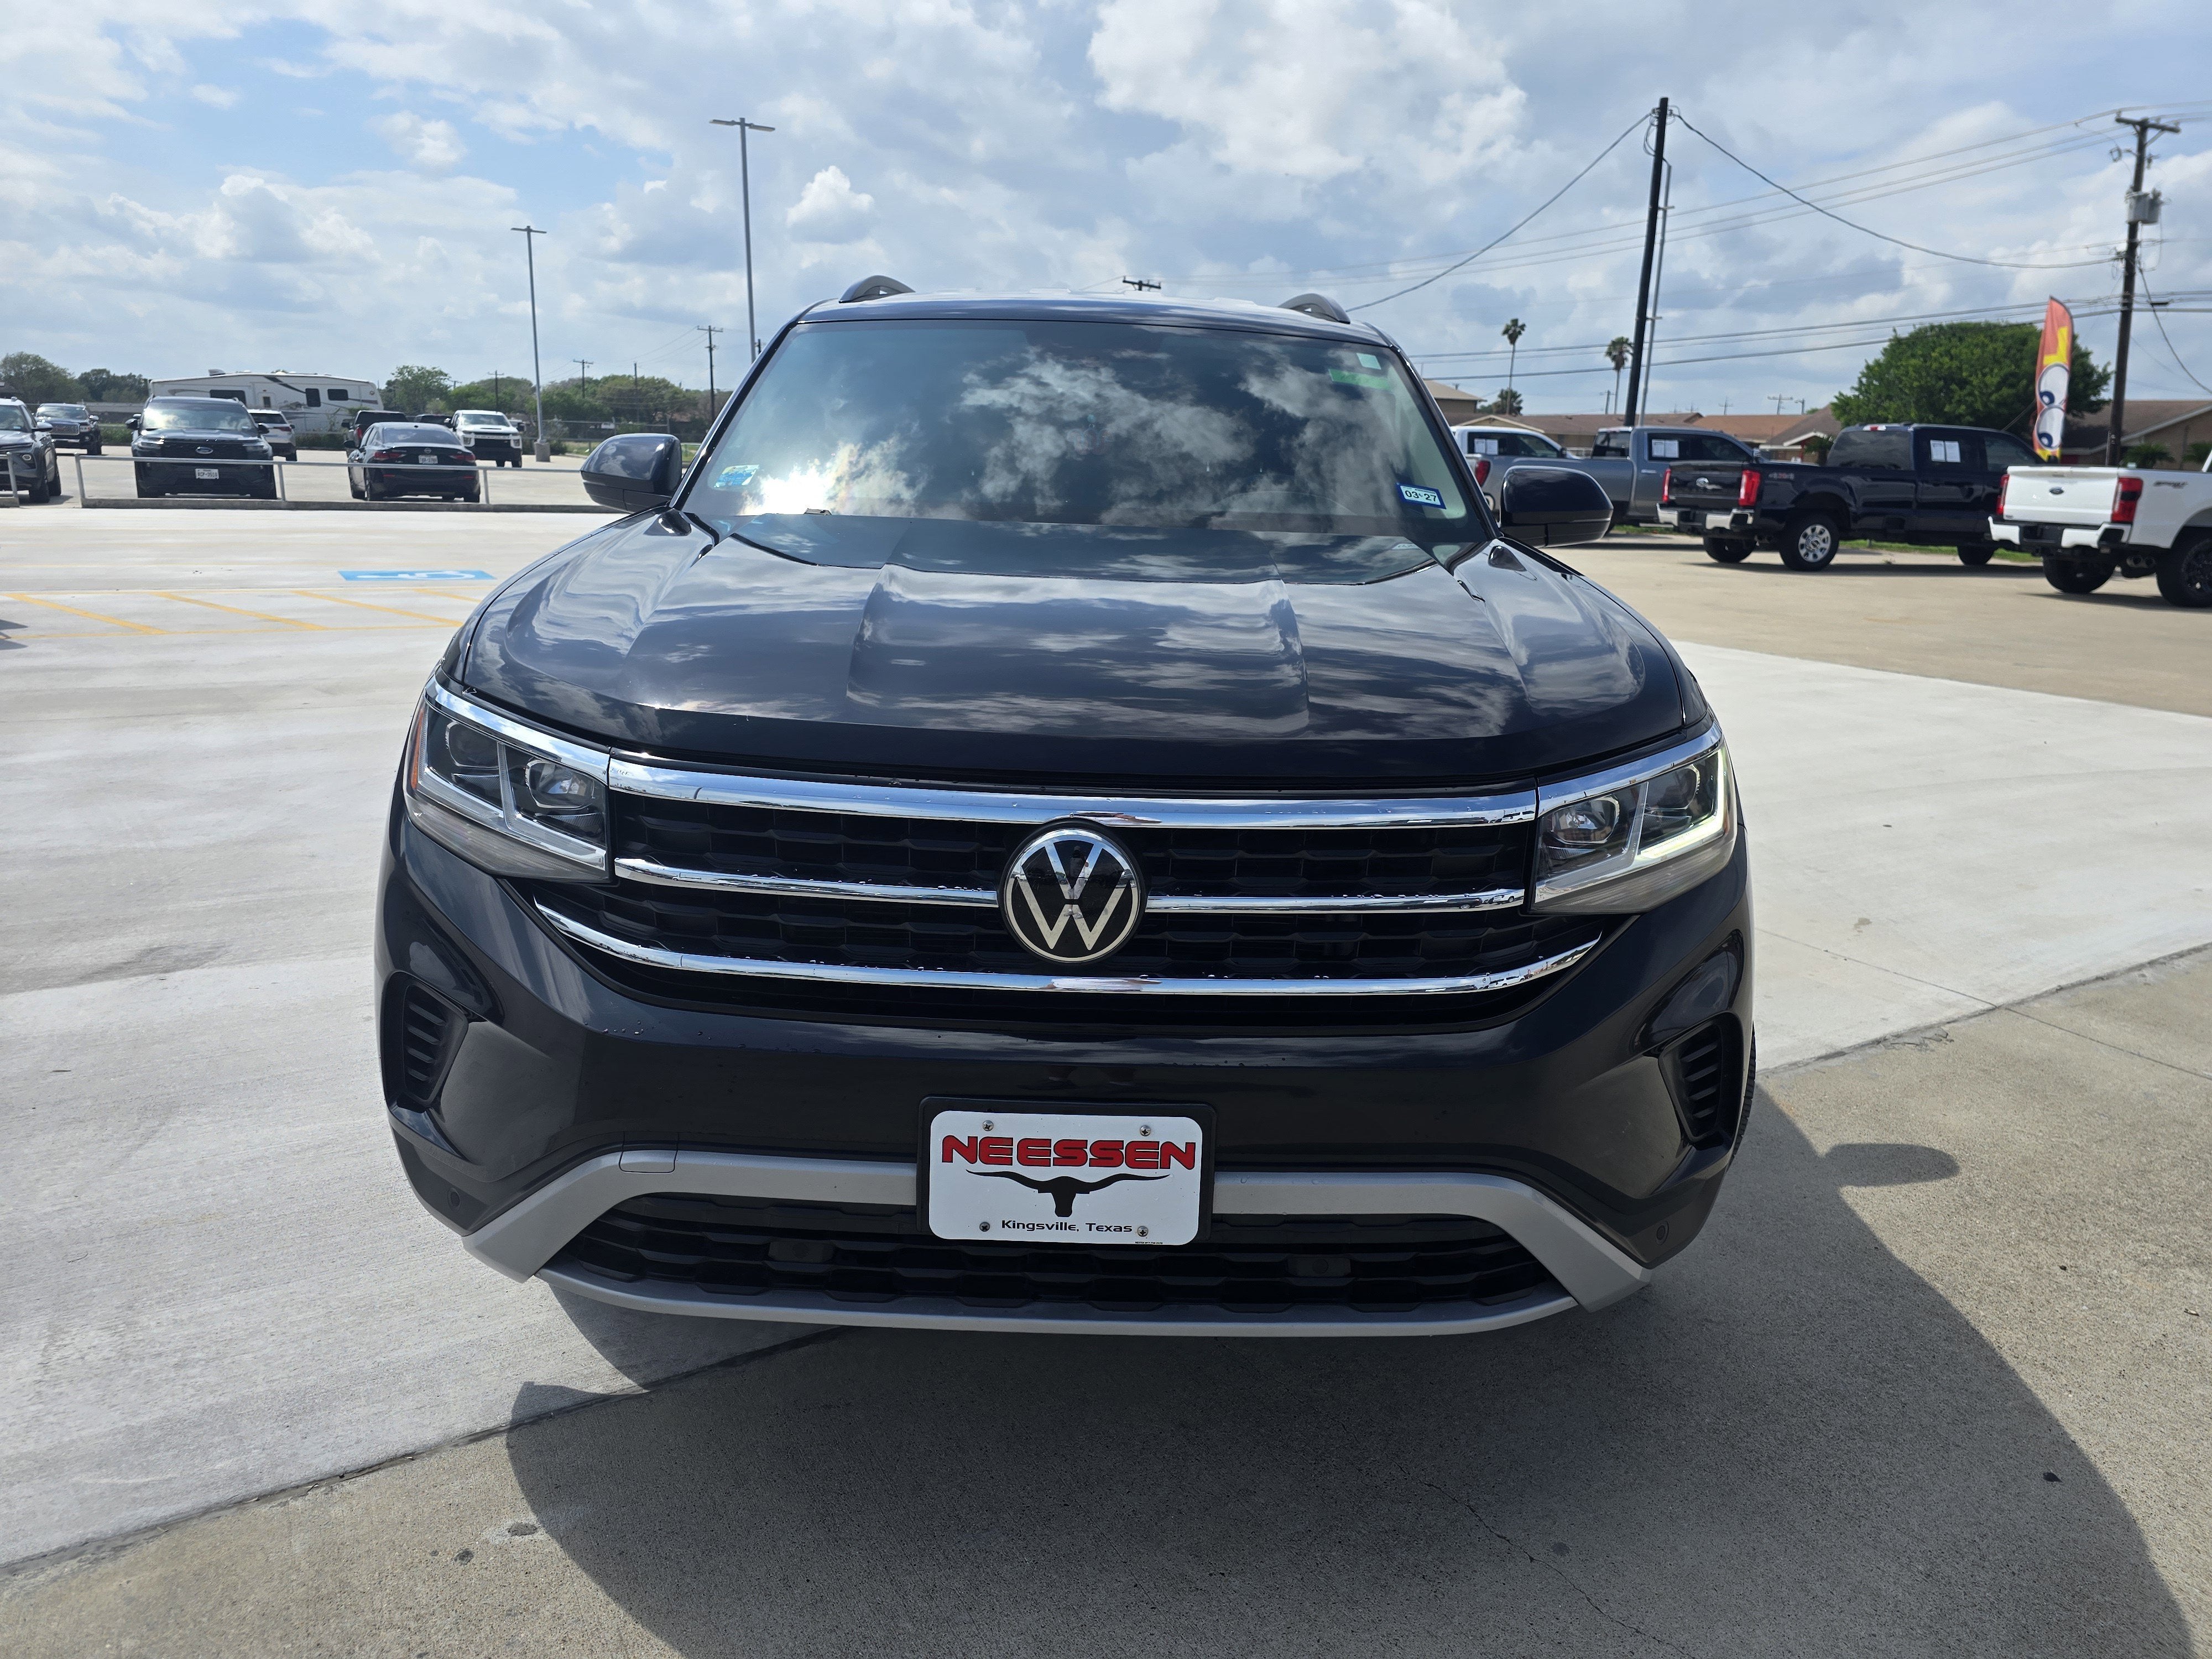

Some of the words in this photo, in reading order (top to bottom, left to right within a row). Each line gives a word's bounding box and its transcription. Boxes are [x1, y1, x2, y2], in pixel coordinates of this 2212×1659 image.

[942, 1135, 1196, 1170] NEESSEN
[1001, 1220, 1079, 1232] Kingsville,
[1086, 1223, 1133, 1233] Texas
